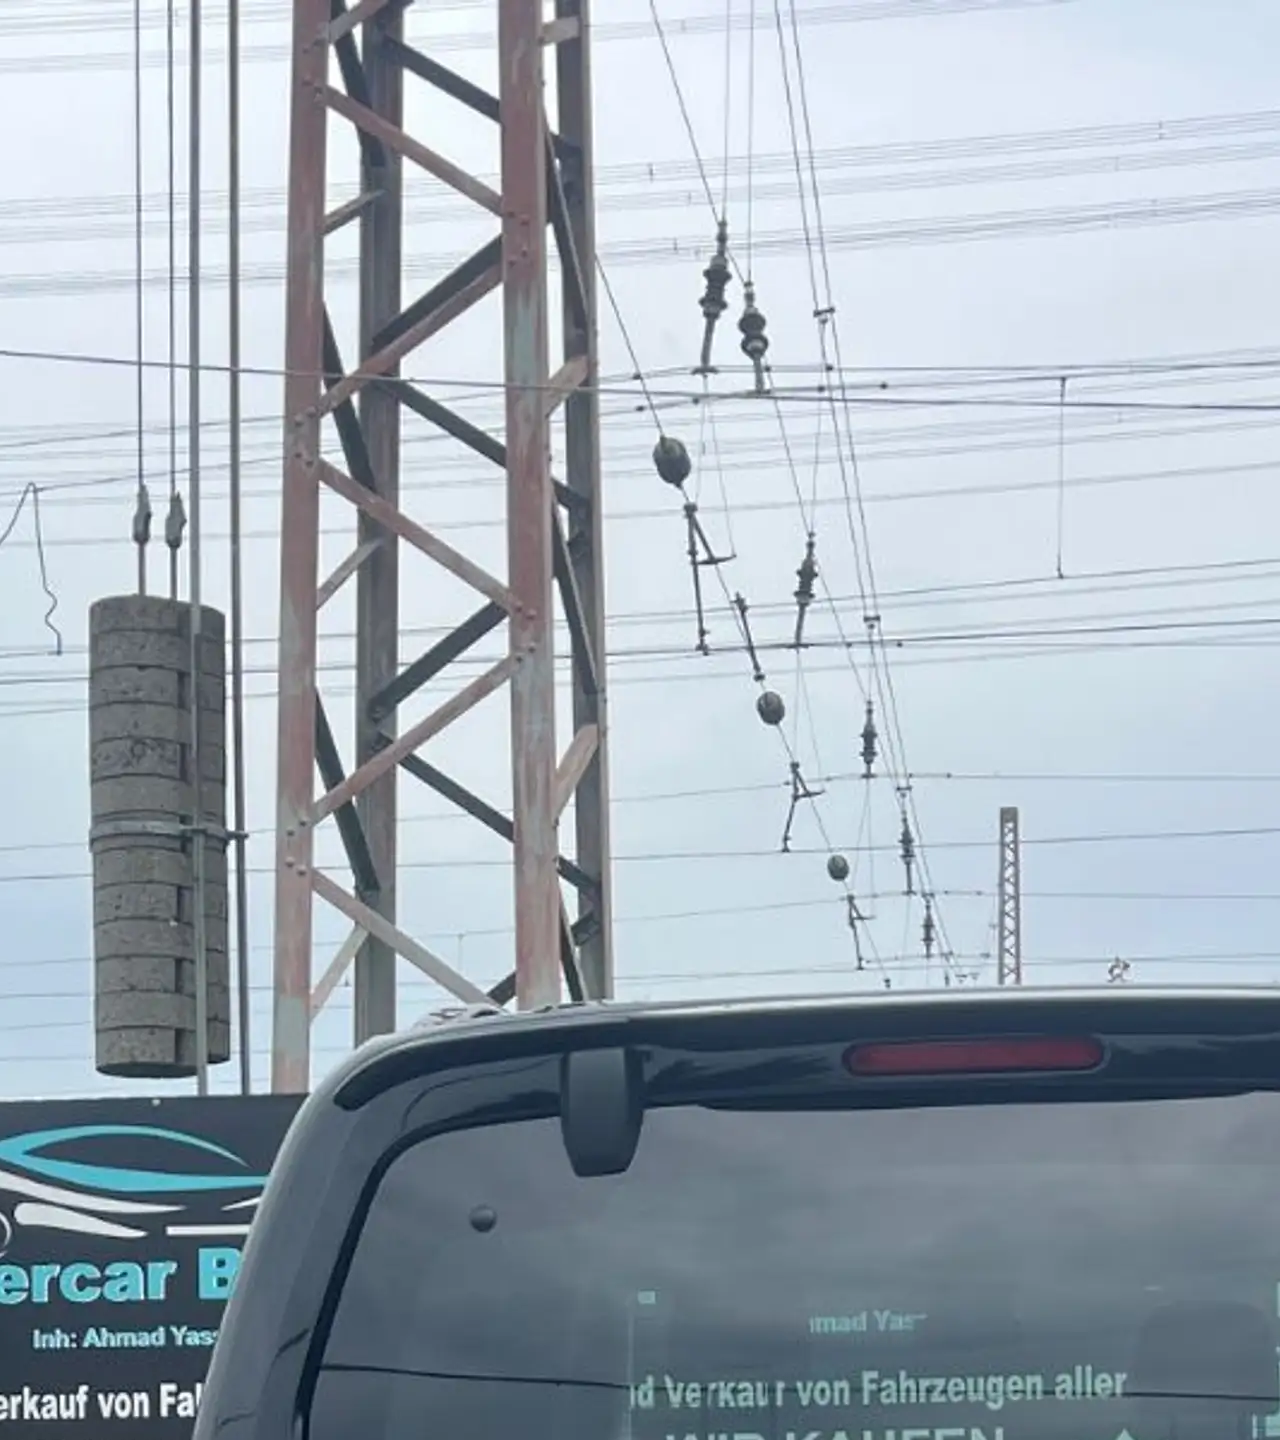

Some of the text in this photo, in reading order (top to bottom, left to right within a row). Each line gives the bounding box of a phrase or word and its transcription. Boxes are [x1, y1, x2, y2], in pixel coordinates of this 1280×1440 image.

[32, 1328, 78, 1351] Inh:
[83, 1326, 166, 1350] Ahmad
[795, 1378, 850, 1407] von
[861, 1369, 1044, 1411] Fahrzeugen
[1054, 1363, 1128, 1401] aller
[97, 1392, 151, 1419] von
